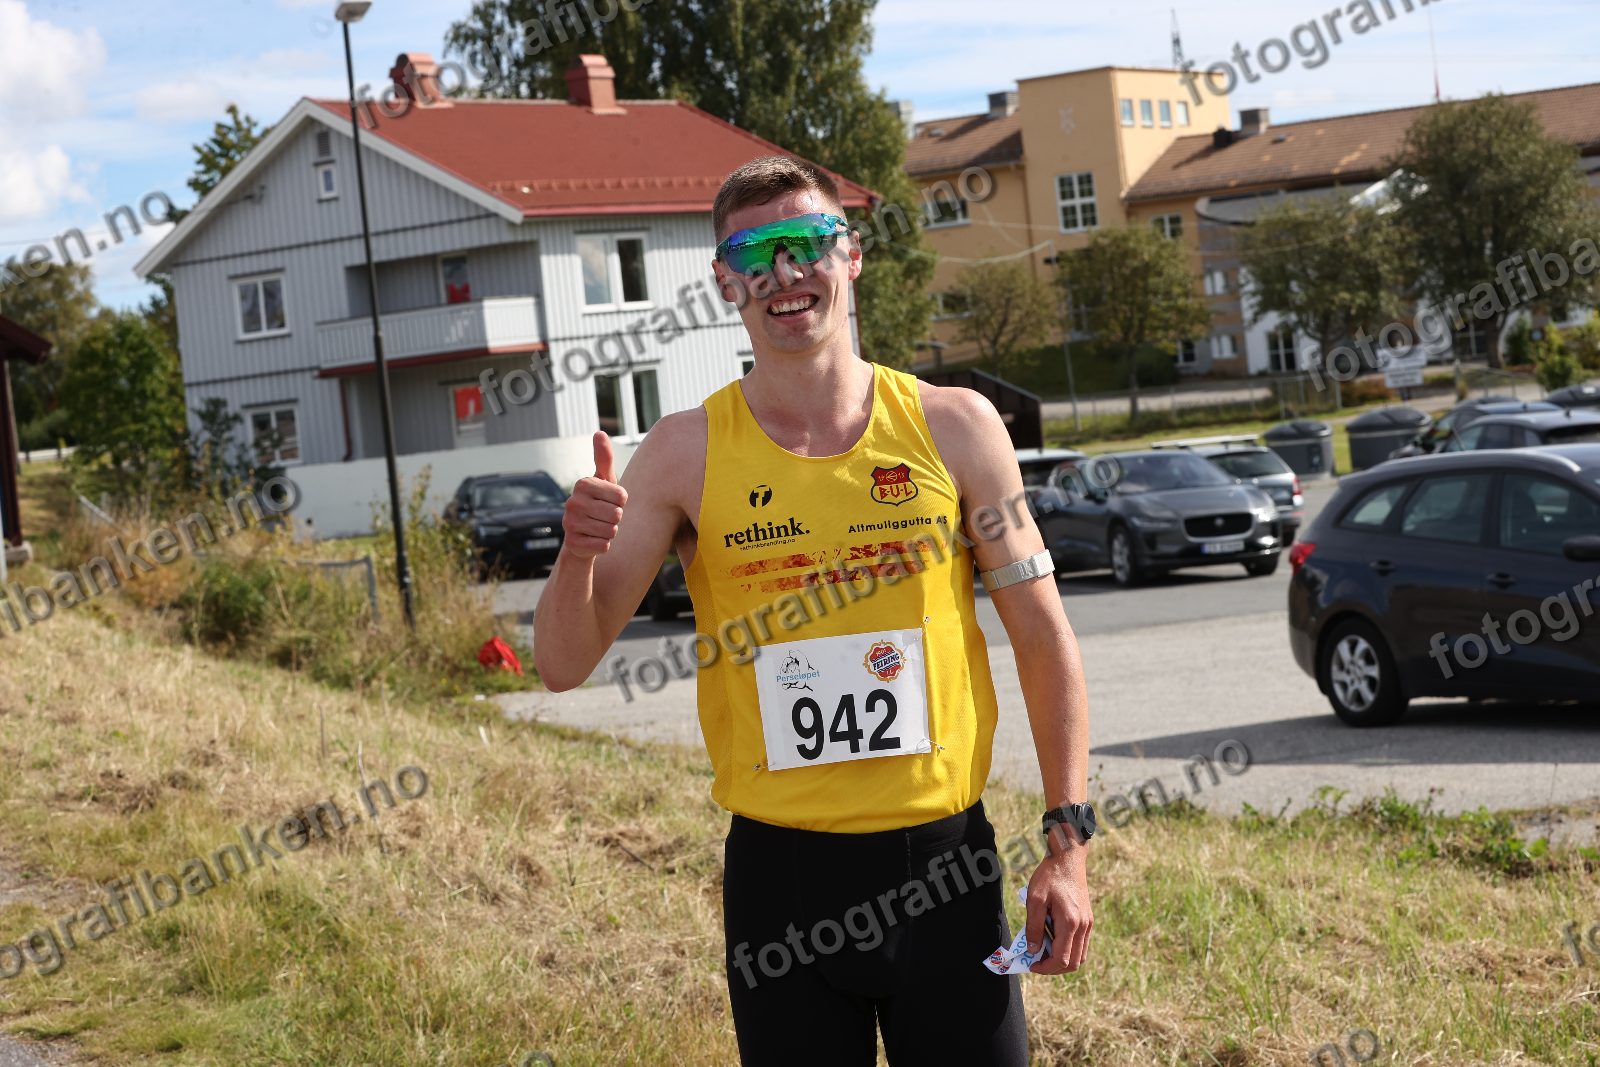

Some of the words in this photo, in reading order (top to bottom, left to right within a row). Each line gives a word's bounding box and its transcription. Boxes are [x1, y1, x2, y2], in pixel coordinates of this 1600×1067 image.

[723, 517, 811, 548] rethink.
[848, 516, 932, 534] Altmuliggutta
[873, 653, 900, 671] FEIRING
[791, 688, 901, 760] 942
